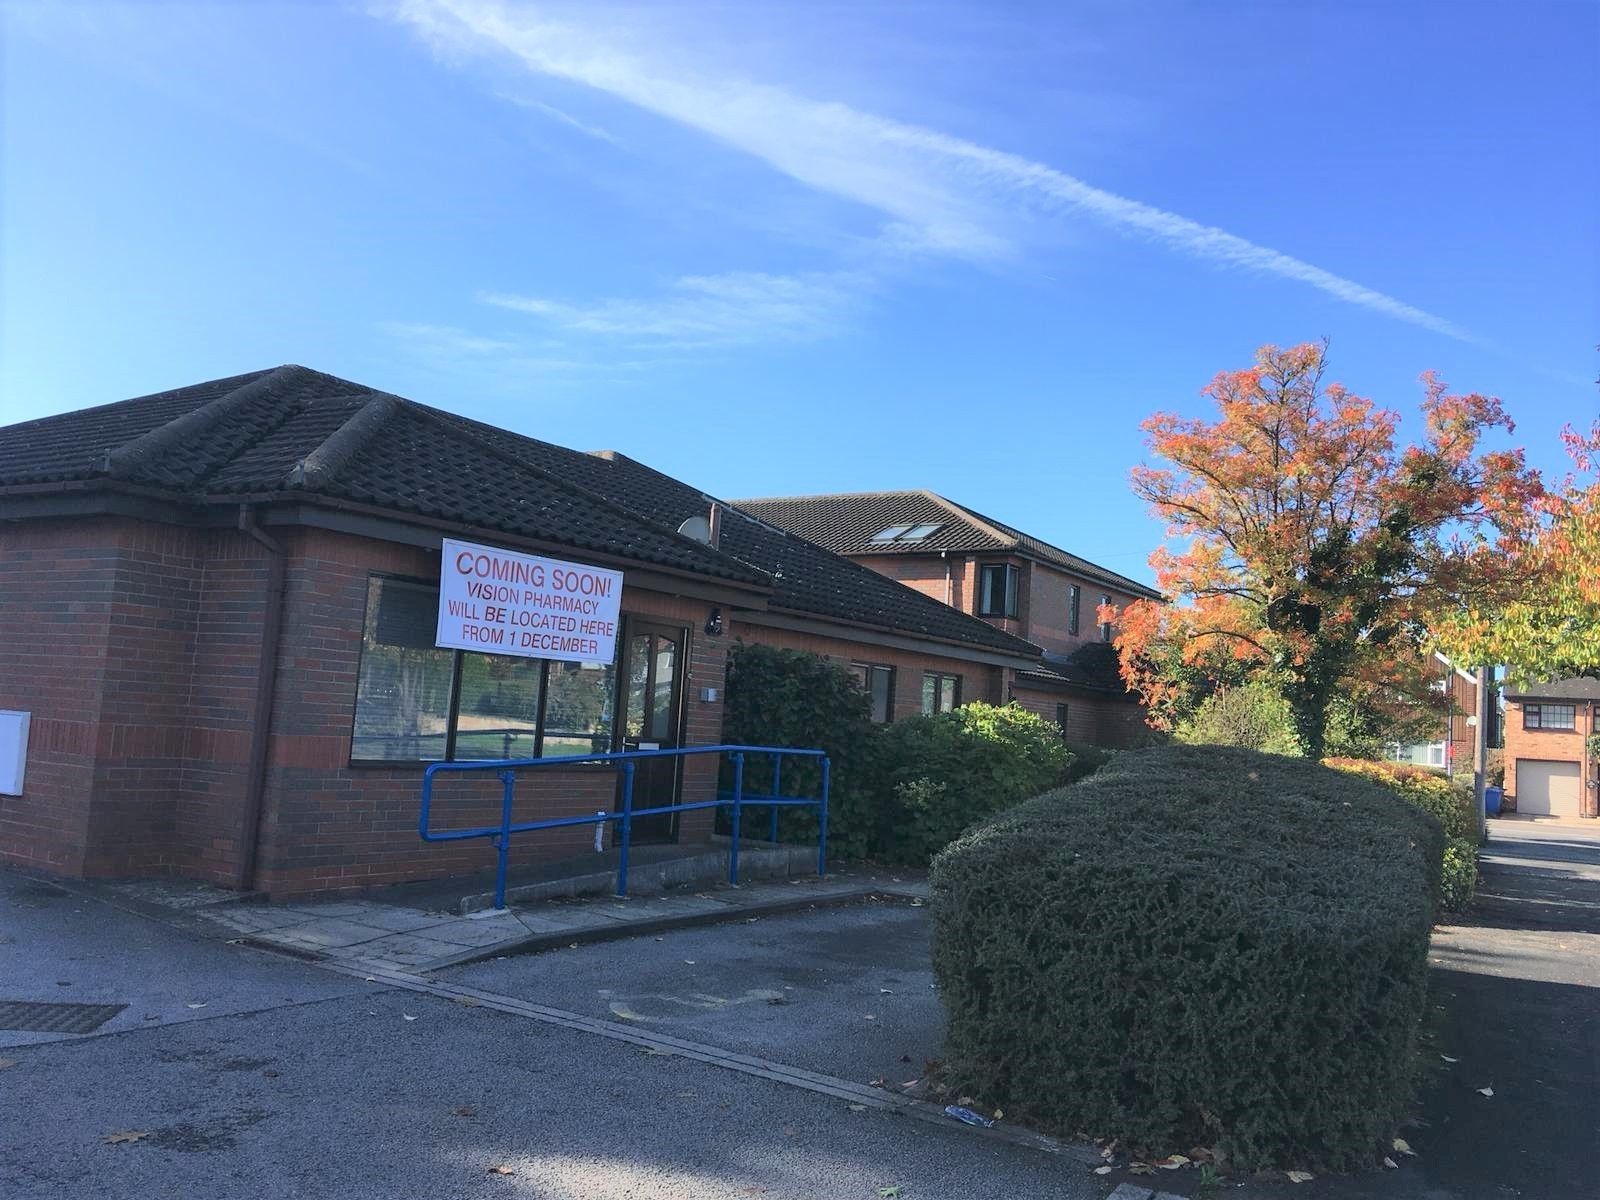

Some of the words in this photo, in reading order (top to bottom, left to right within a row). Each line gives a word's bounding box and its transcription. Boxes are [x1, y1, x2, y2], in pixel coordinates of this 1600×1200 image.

[456, 552, 545, 588] COMING
[552, 569, 612, 598] SOON!
[467, 581, 520, 605] VISION
[524, 591, 600, 615] PHARMACY
[448, 599, 480, 620] WILL
[484, 606, 507, 624] BE
[511, 610, 577, 632] LOCATED
[580, 620, 614, 637] HERE
[462, 624, 504, 644] FROM
[509, 631, 516, 646] 1
[521, 632, 598, 655] DECEMBER
